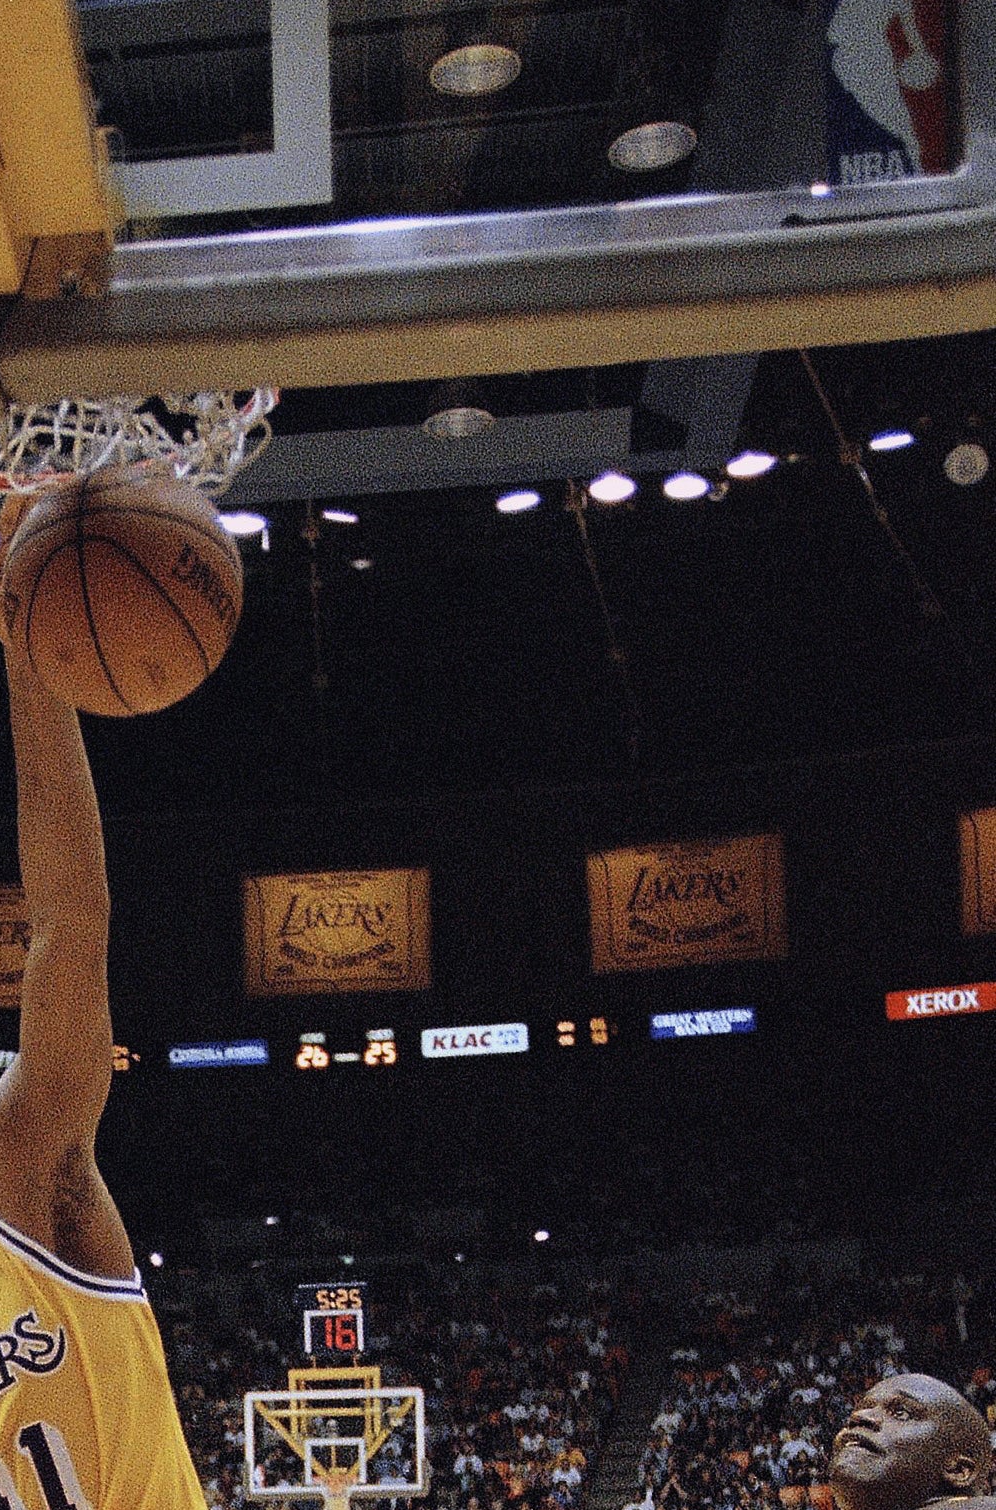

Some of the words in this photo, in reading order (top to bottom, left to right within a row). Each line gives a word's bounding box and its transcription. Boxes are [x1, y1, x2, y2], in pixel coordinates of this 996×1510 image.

[838, 149, 906, 185] NBA
[278, 894, 392, 937] LAKERS
[906, 989, 980, 1016] XEROX
[364, 1040, 397, 1066] 25
[433, 1030, 492, 1050] KLAC
[296, 1044, 329, 1069] 26
[315, 1287, 363, 1310] 5:25
[323, 1313, 356, 1350] 16
